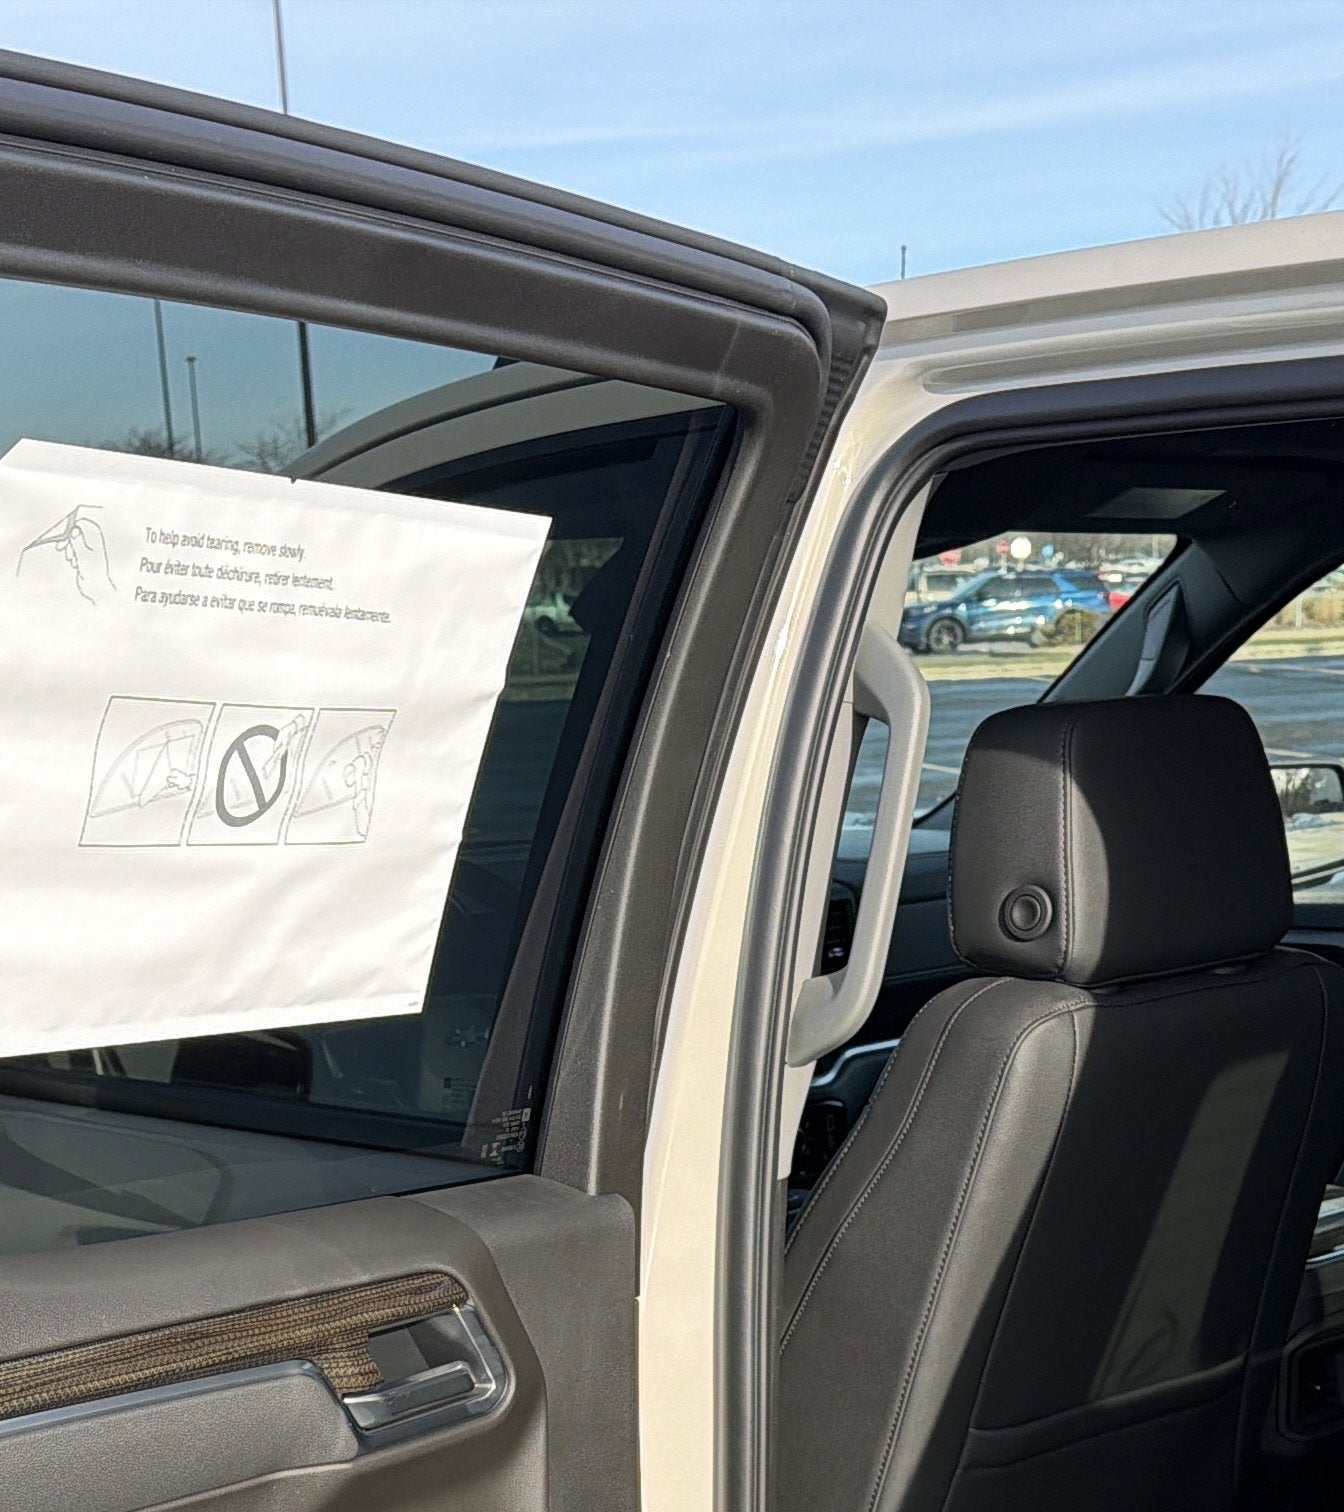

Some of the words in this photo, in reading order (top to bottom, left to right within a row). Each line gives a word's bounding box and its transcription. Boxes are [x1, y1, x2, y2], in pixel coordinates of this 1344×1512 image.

[146, 526, 158, 544] To
[159, 528, 179, 549] help
[181, 532, 205, 549] avoid
[206, 535, 241, 556] tearing,
[243, 540, 277, 557] remove
[278, 543, 306, 563] slowly.
[140, 557, 163, 575] Pour
[164, 558, 190, 577] éviter
[191, 561, 214, 579] toute
[264, 570, 290, 587] retirer
[134, 585, 157, 604] Para
[158, 589, 200, 608] ayudarse
[201, 595, 209, 608] a
[210, 593, 237, 610] evitar
[238, 598, 255, 614] que
[256, 600, 269, 613] se
